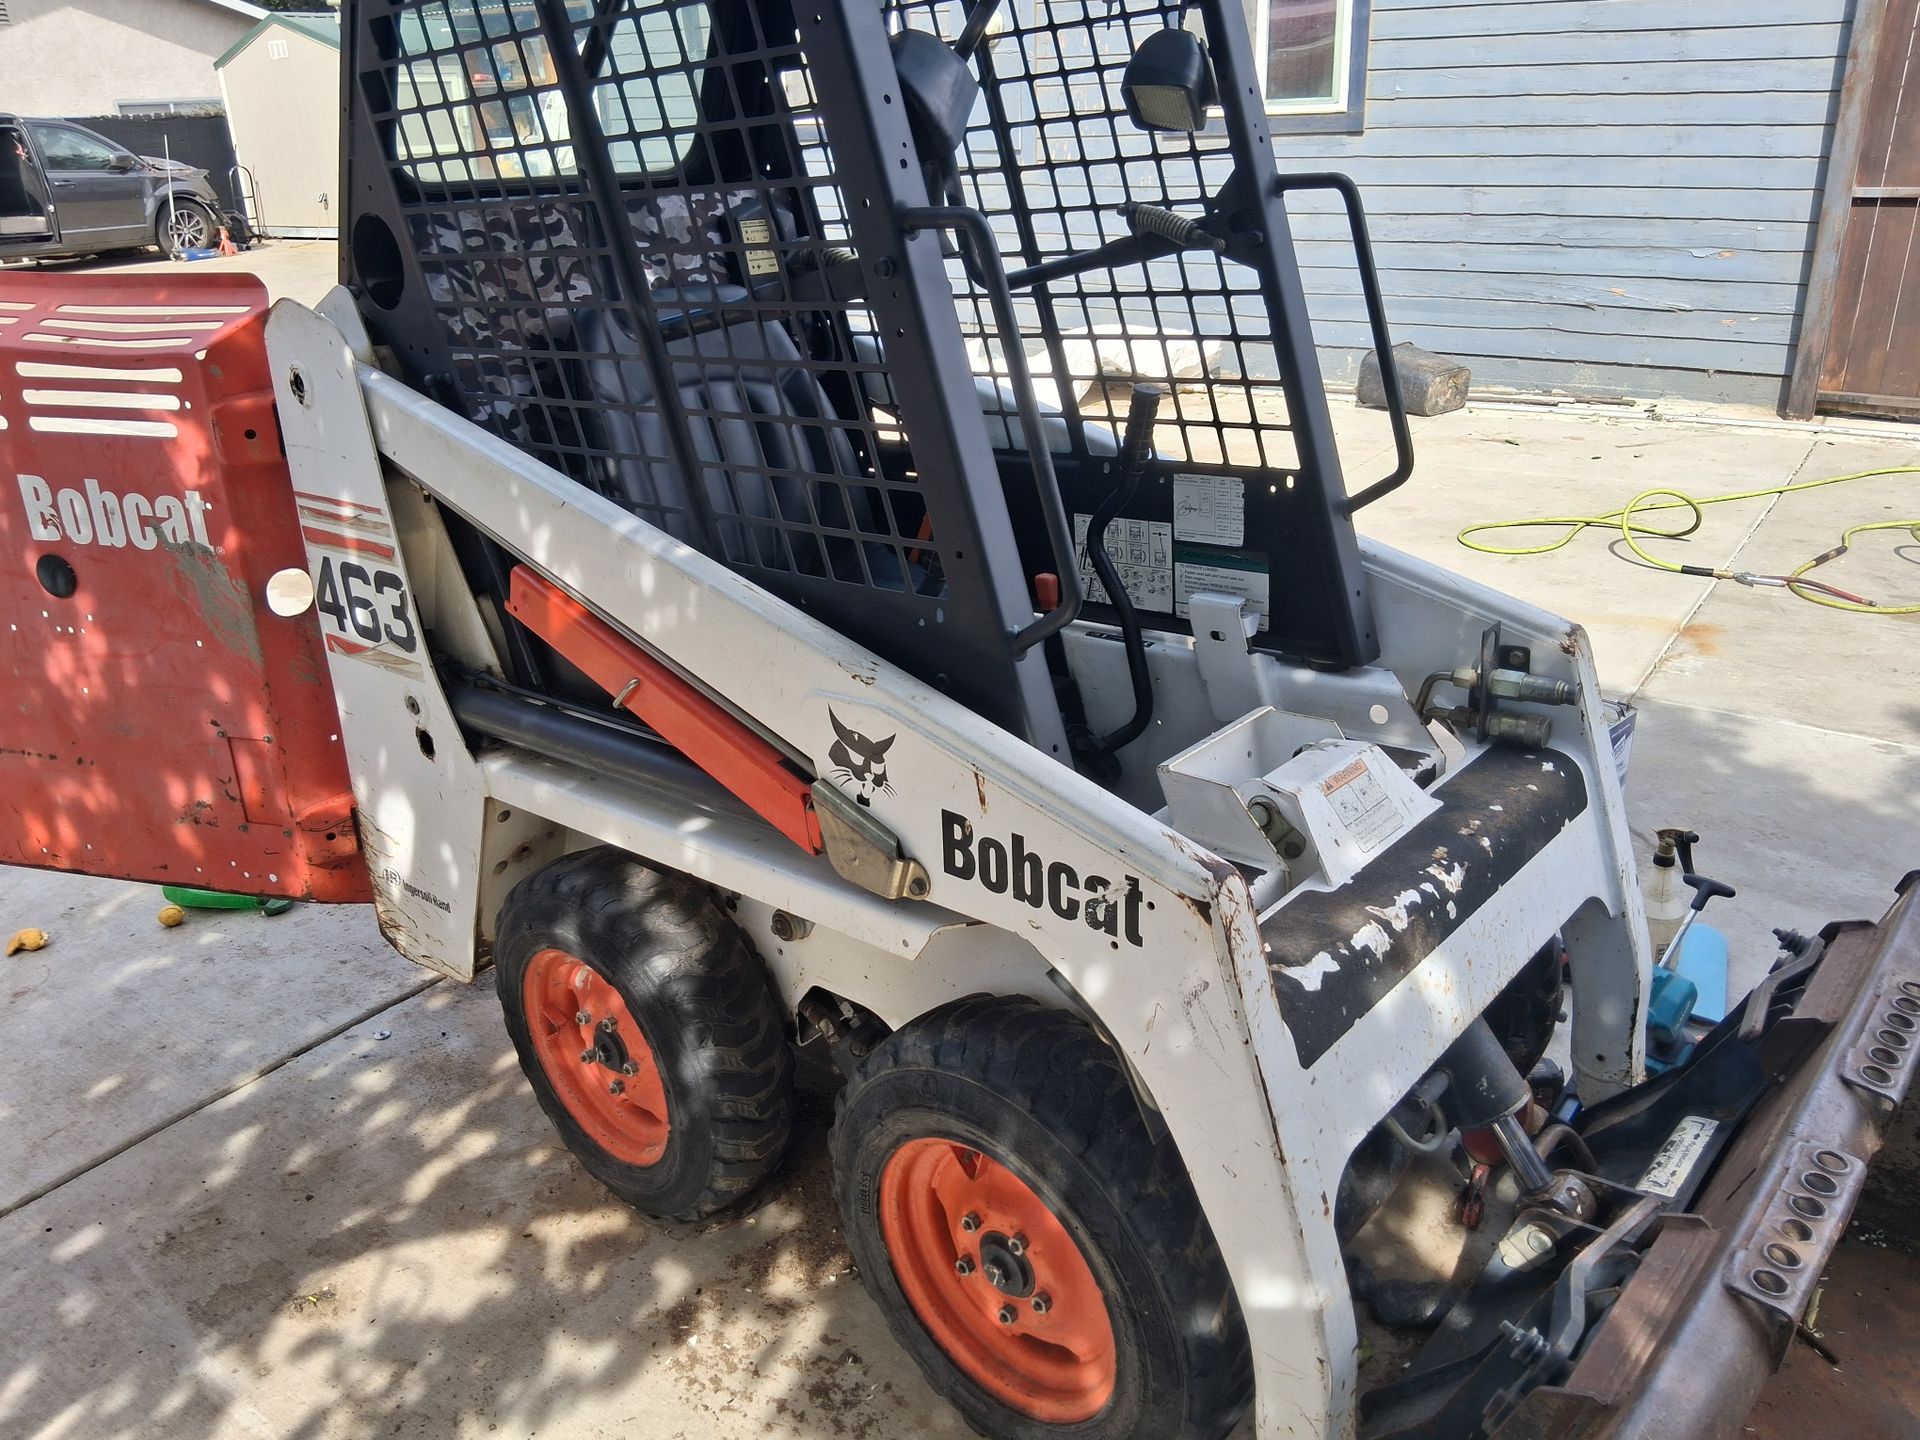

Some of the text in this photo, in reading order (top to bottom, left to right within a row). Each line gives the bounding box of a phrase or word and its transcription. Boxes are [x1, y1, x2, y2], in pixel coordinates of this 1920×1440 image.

[17, 474, 215, 554] Bobcat
[317, 556, 416, 653] 463
[941, 809, 1144, 947] Bobcat
